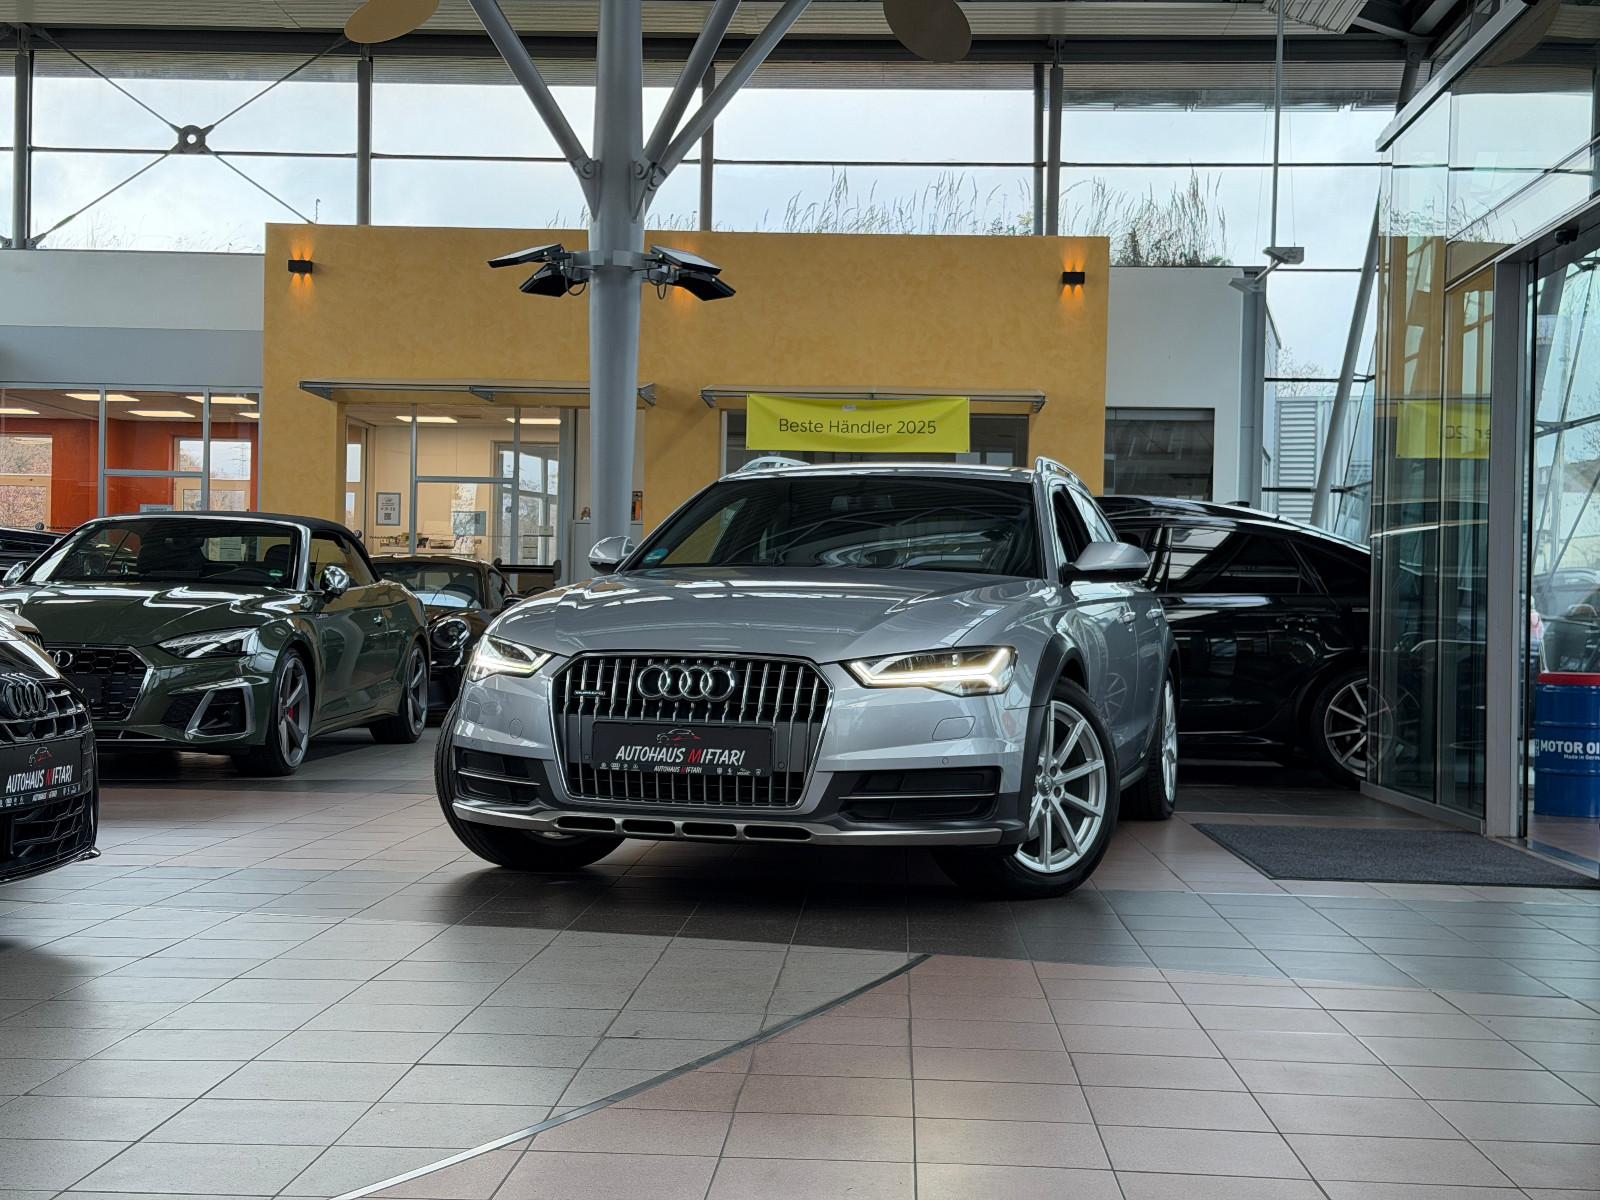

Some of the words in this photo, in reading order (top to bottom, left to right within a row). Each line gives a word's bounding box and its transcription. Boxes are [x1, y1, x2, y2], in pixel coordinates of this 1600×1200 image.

[779, 418, 824, 433] Beste
[829, 419, 892, 434] Händler
[896, 420, 937, 435] 2025
[615, 745, 685, 763] AUTOHAUS
[687, 748, 746, 766] MIFTARI
[1540, 739, 1584, 754] MOTOR
[1586, 742, 1600, 755] OI
[653, 765, 680, 773] AUTOHAUS
[680, 766, 702, 774] MIFTARI
[5, 769, 45, 794] AUTOHAUS
[46, 764, 74, 786] MIFTARI
